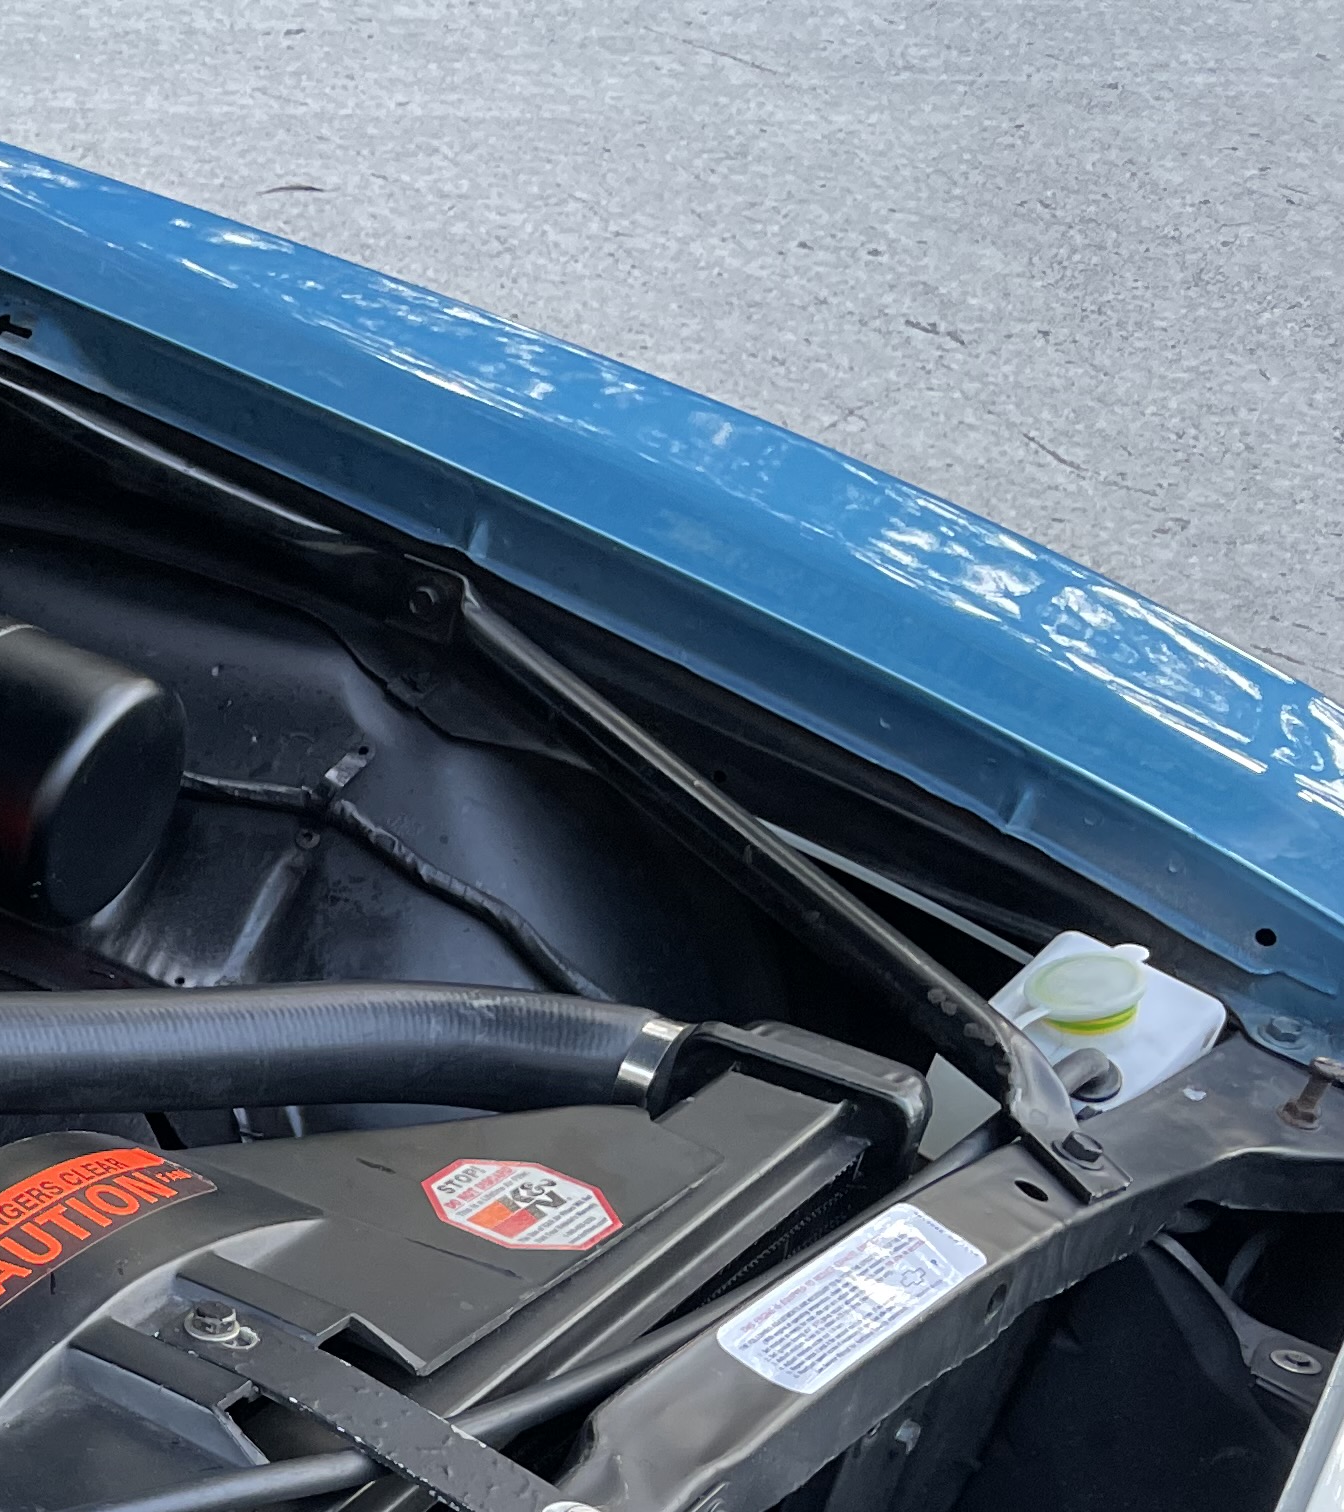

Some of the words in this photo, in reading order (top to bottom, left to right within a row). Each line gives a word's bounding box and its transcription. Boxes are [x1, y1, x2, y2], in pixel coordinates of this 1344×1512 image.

[60, 1157, 129, 1191] CLEAR
[437, 1166, 487, 1193] STOP!
[497, 1179, 567, 1219] K&N
